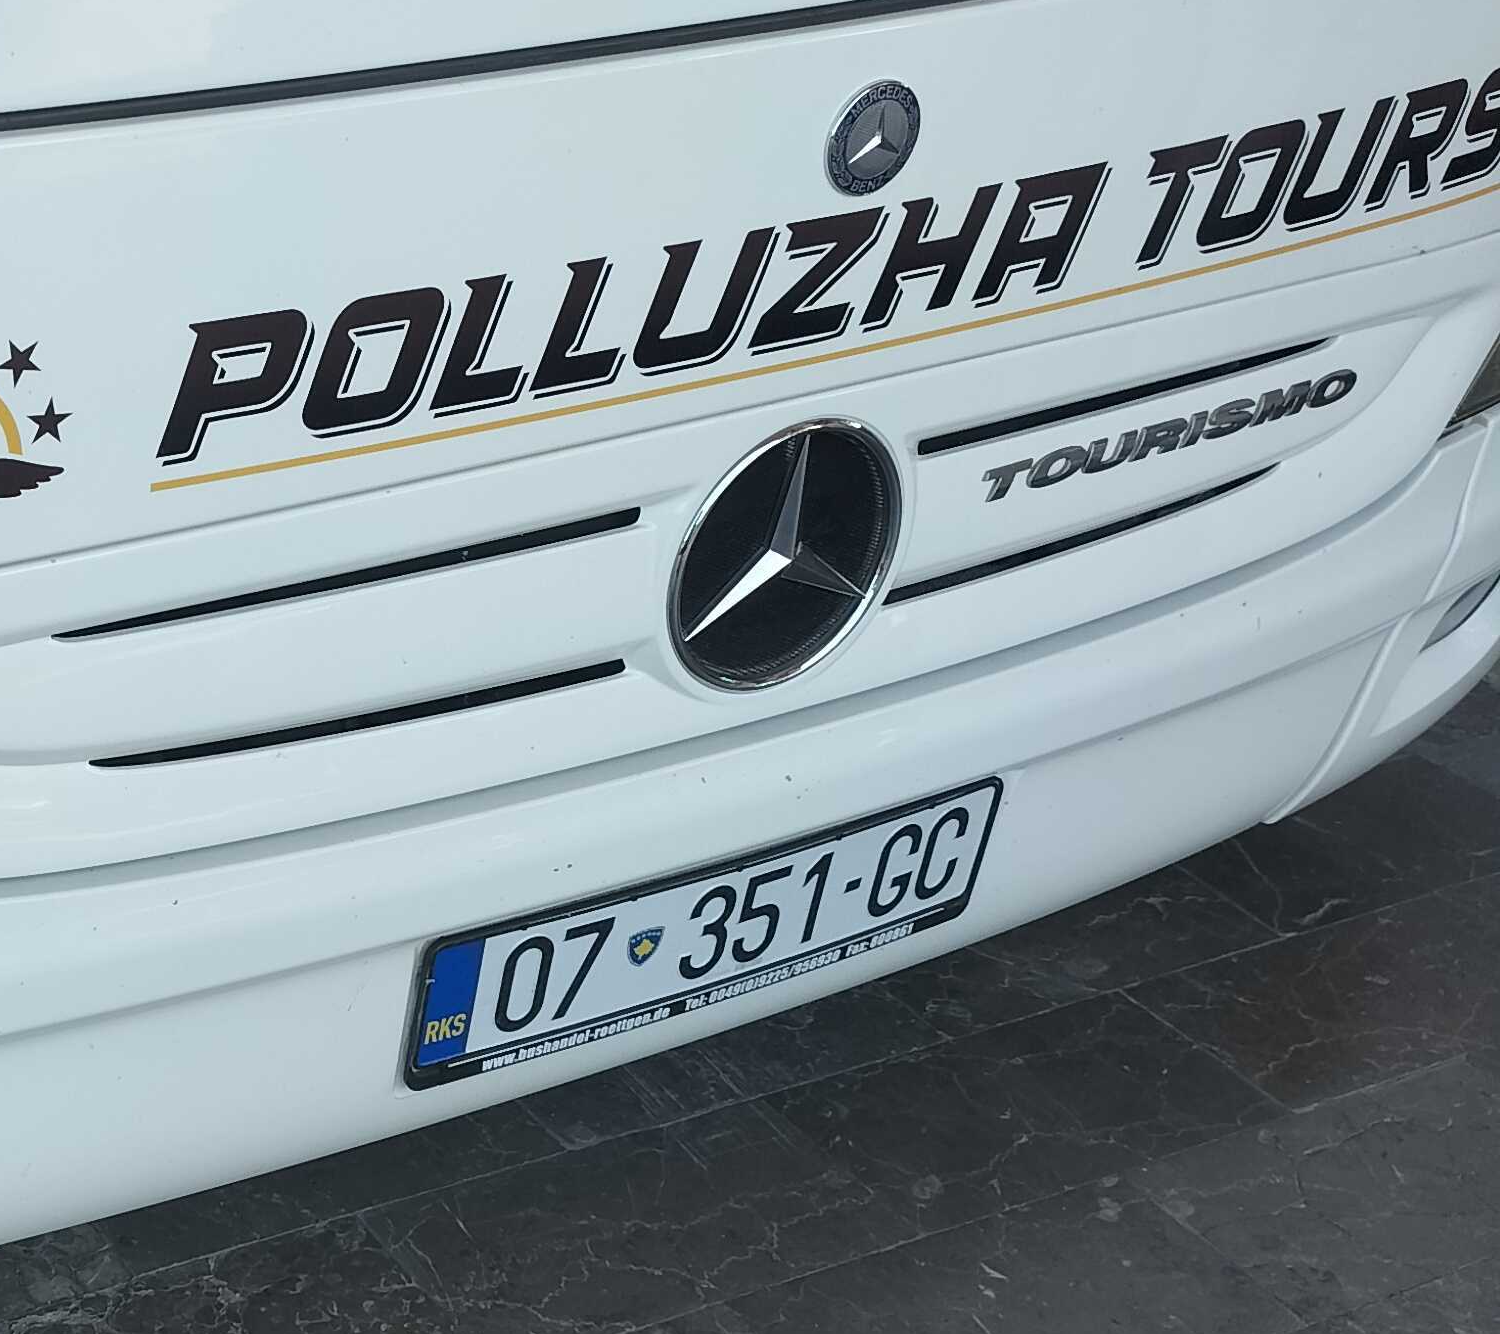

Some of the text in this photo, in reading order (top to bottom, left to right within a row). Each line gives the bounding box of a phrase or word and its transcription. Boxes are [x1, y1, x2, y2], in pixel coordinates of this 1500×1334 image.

[850, 86, 913, 119] MERCEDES
[850, 174, 885, 193] BENZ
[156, 66, 1500, 466] POLLUZHA TOURS
[982, 369, 1357, 503] TOURISMO
[494, 806, 970, 1033] 07 351-GC
[423, 1013, 467, 1045] RKS
